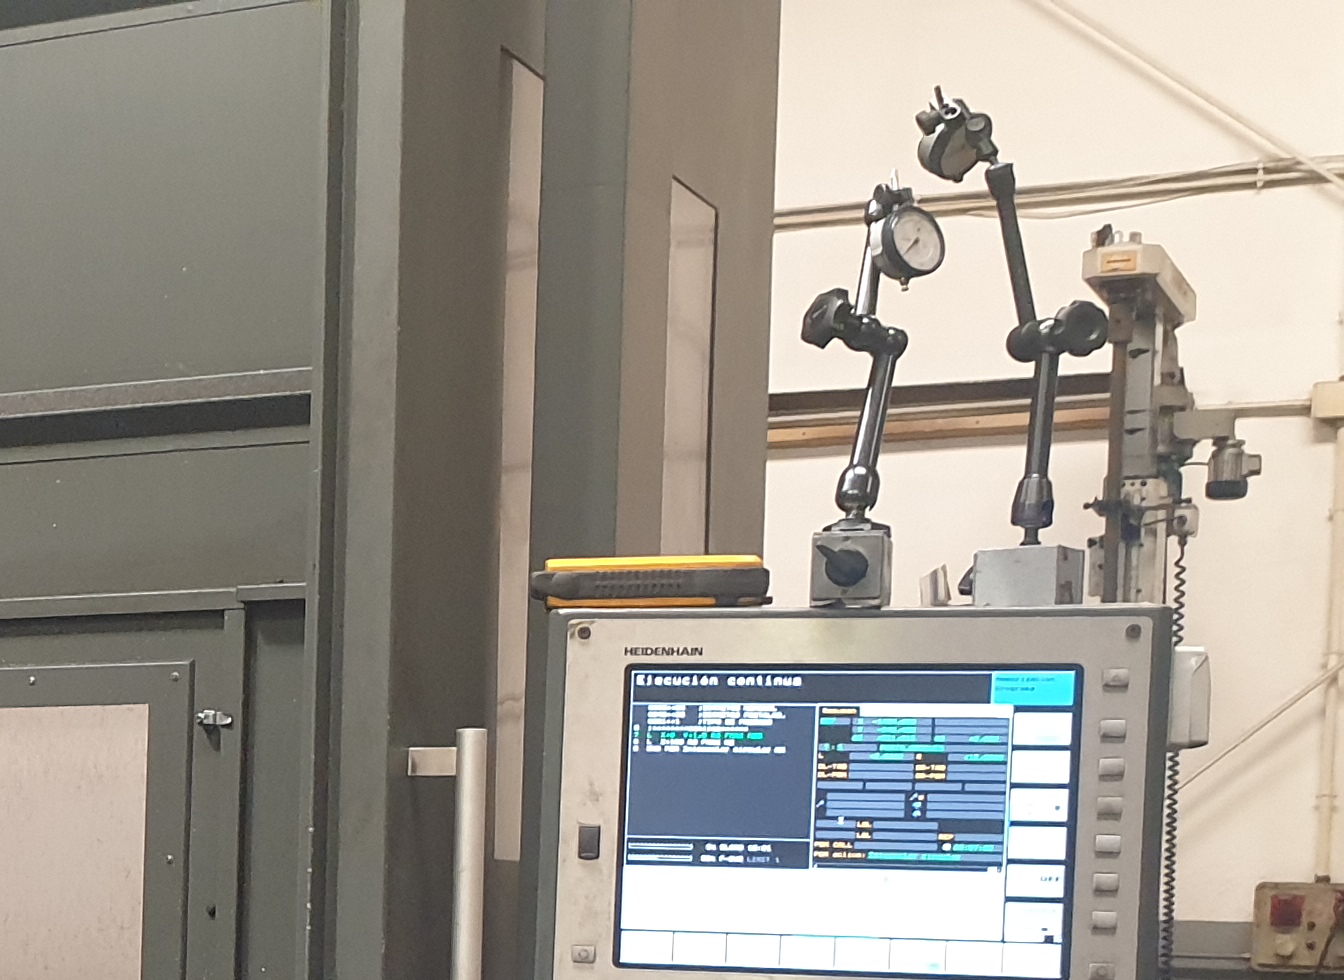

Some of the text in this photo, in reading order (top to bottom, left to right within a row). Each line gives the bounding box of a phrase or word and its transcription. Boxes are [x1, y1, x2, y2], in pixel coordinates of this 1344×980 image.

[624, 646, 703, 656] HEIDENHAIN
[635, 674, 802, 687] Ejecución continua
